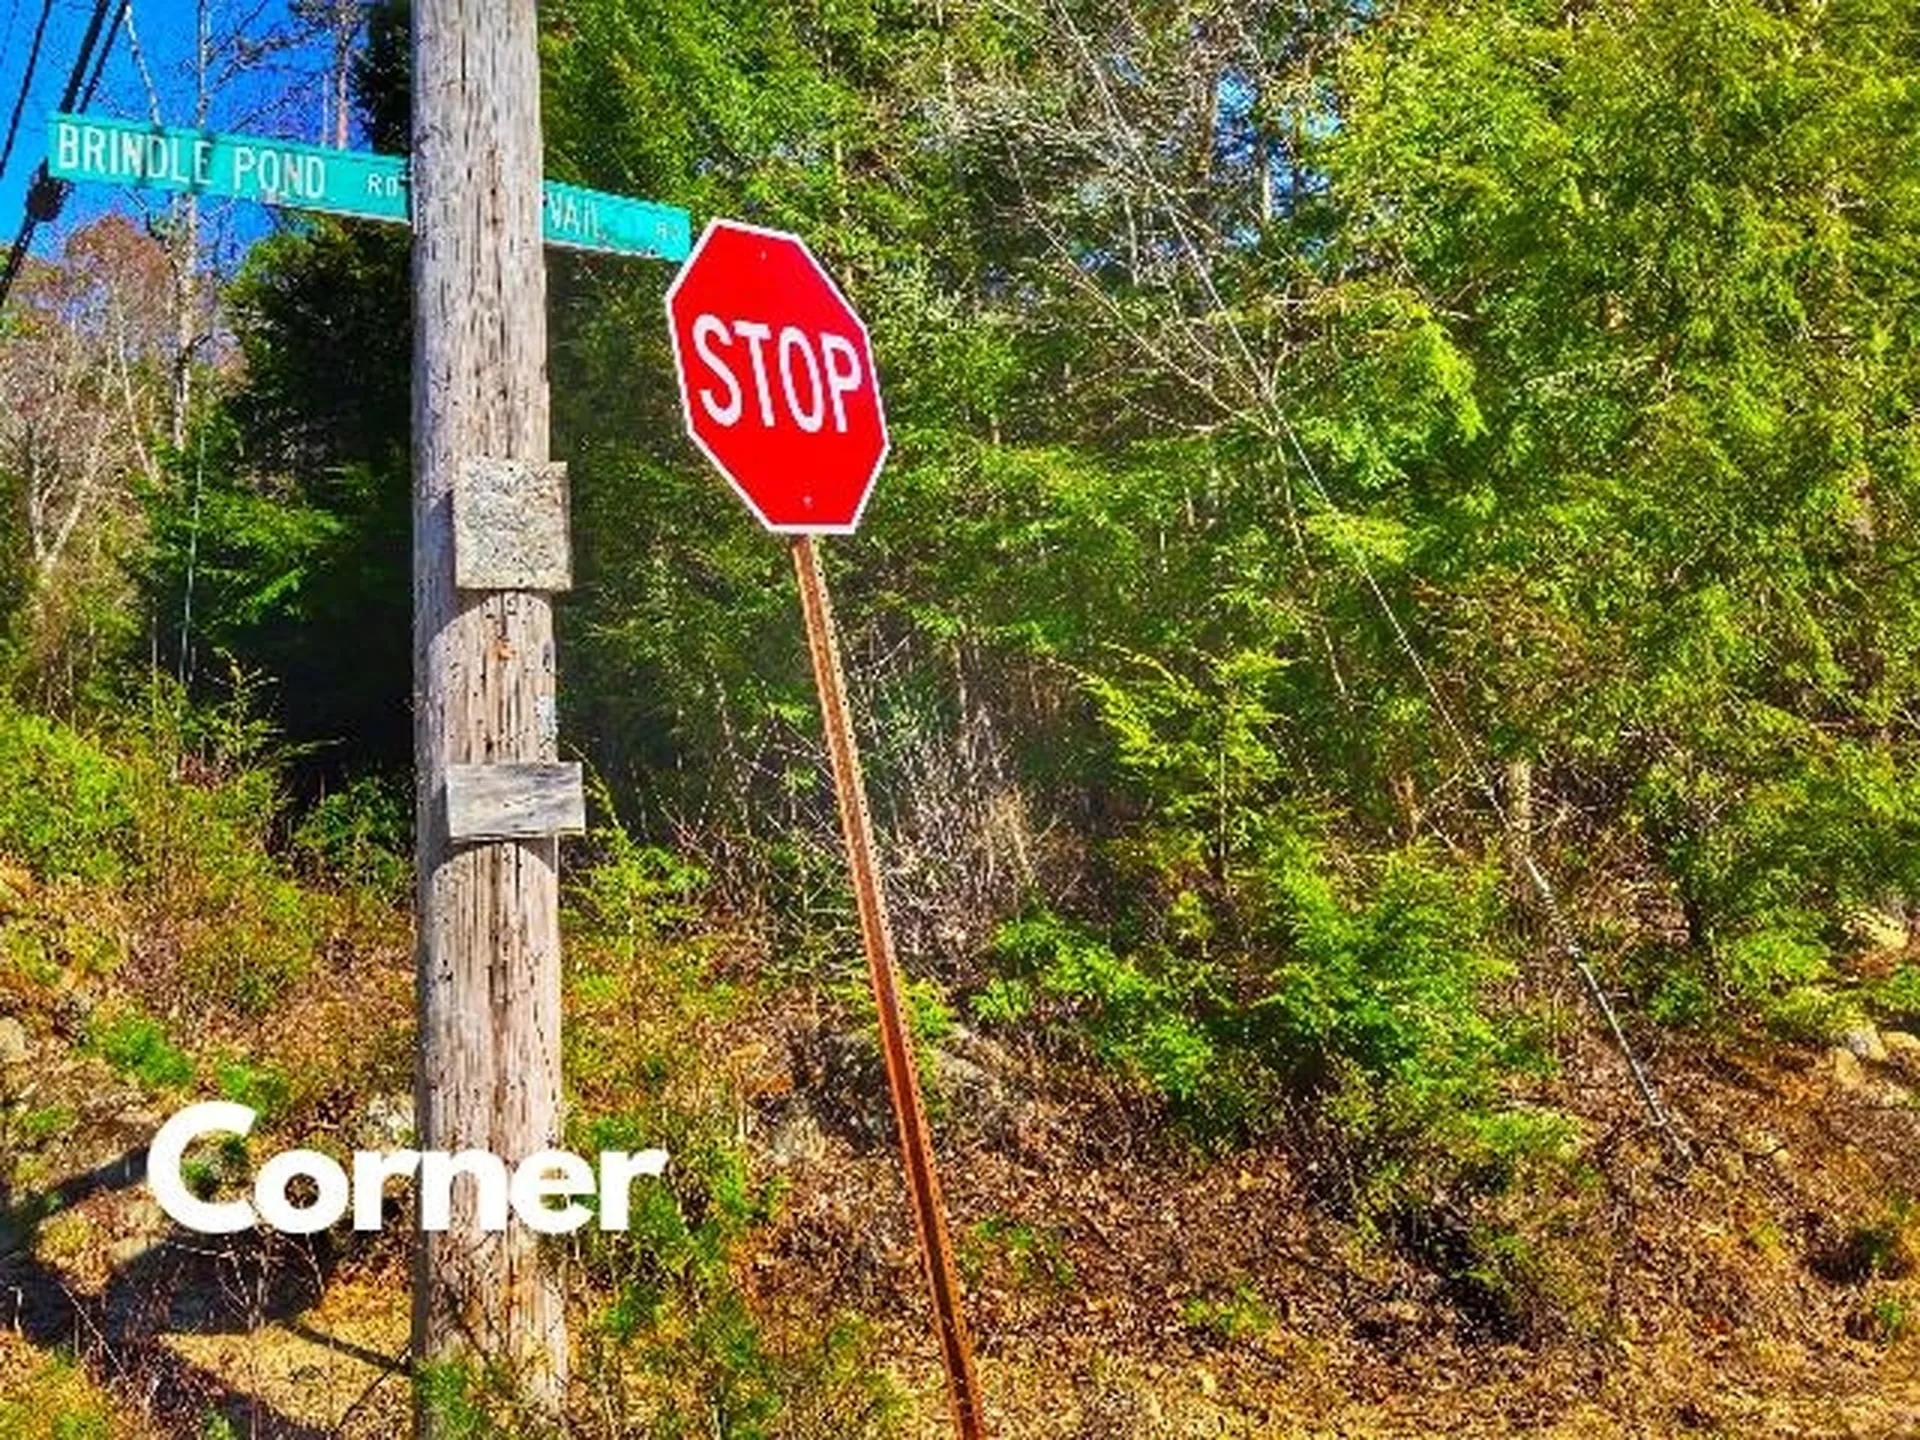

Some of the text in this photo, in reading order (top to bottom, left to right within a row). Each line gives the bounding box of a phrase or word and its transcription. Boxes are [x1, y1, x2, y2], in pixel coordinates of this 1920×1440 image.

[57, 122, 398, 198] BRINDLE POND RD
[692, 314, 862, 433] STOP
